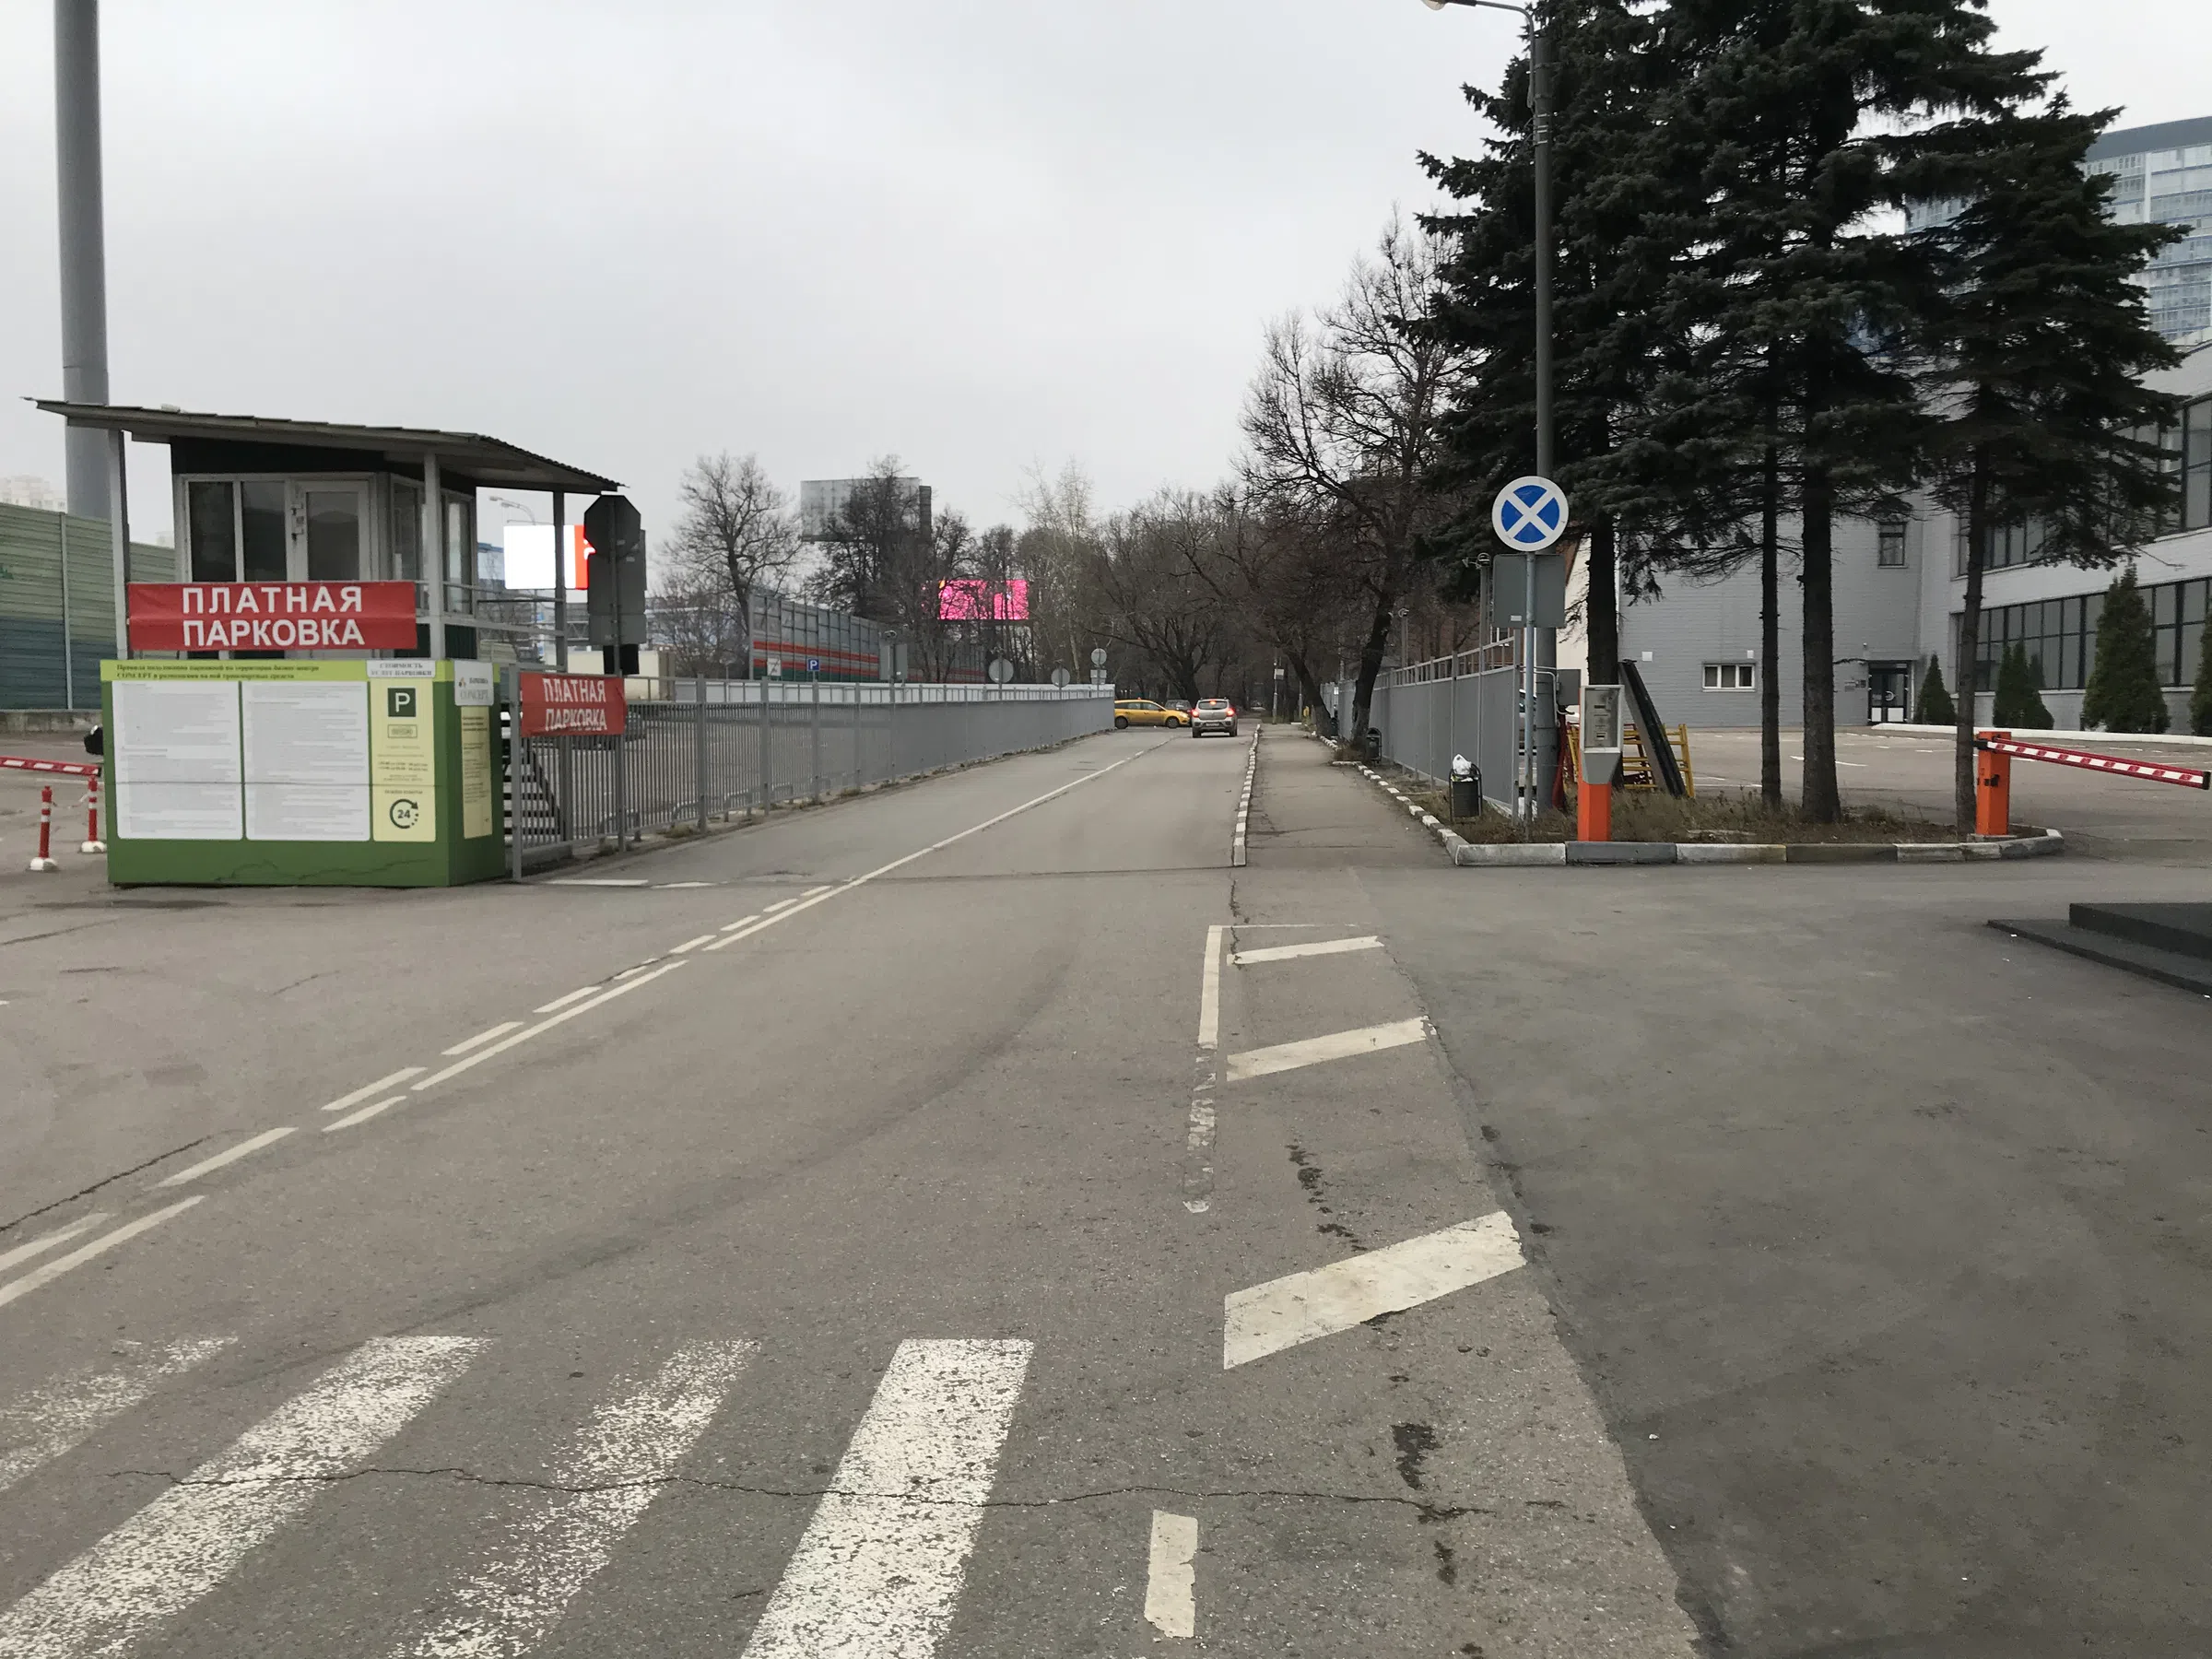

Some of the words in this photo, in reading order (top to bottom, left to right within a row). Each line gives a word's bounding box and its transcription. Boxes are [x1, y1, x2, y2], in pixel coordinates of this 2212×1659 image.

[182, 586, 362, 614] ПЛАТНАЯ
[182, 618, 365, 646] ПАРКОВКА
[542, 677, 606, 702] ПЛАТНАЯ
[394, 692, 411, 713] P
[396, 809, 411, 819] 24
